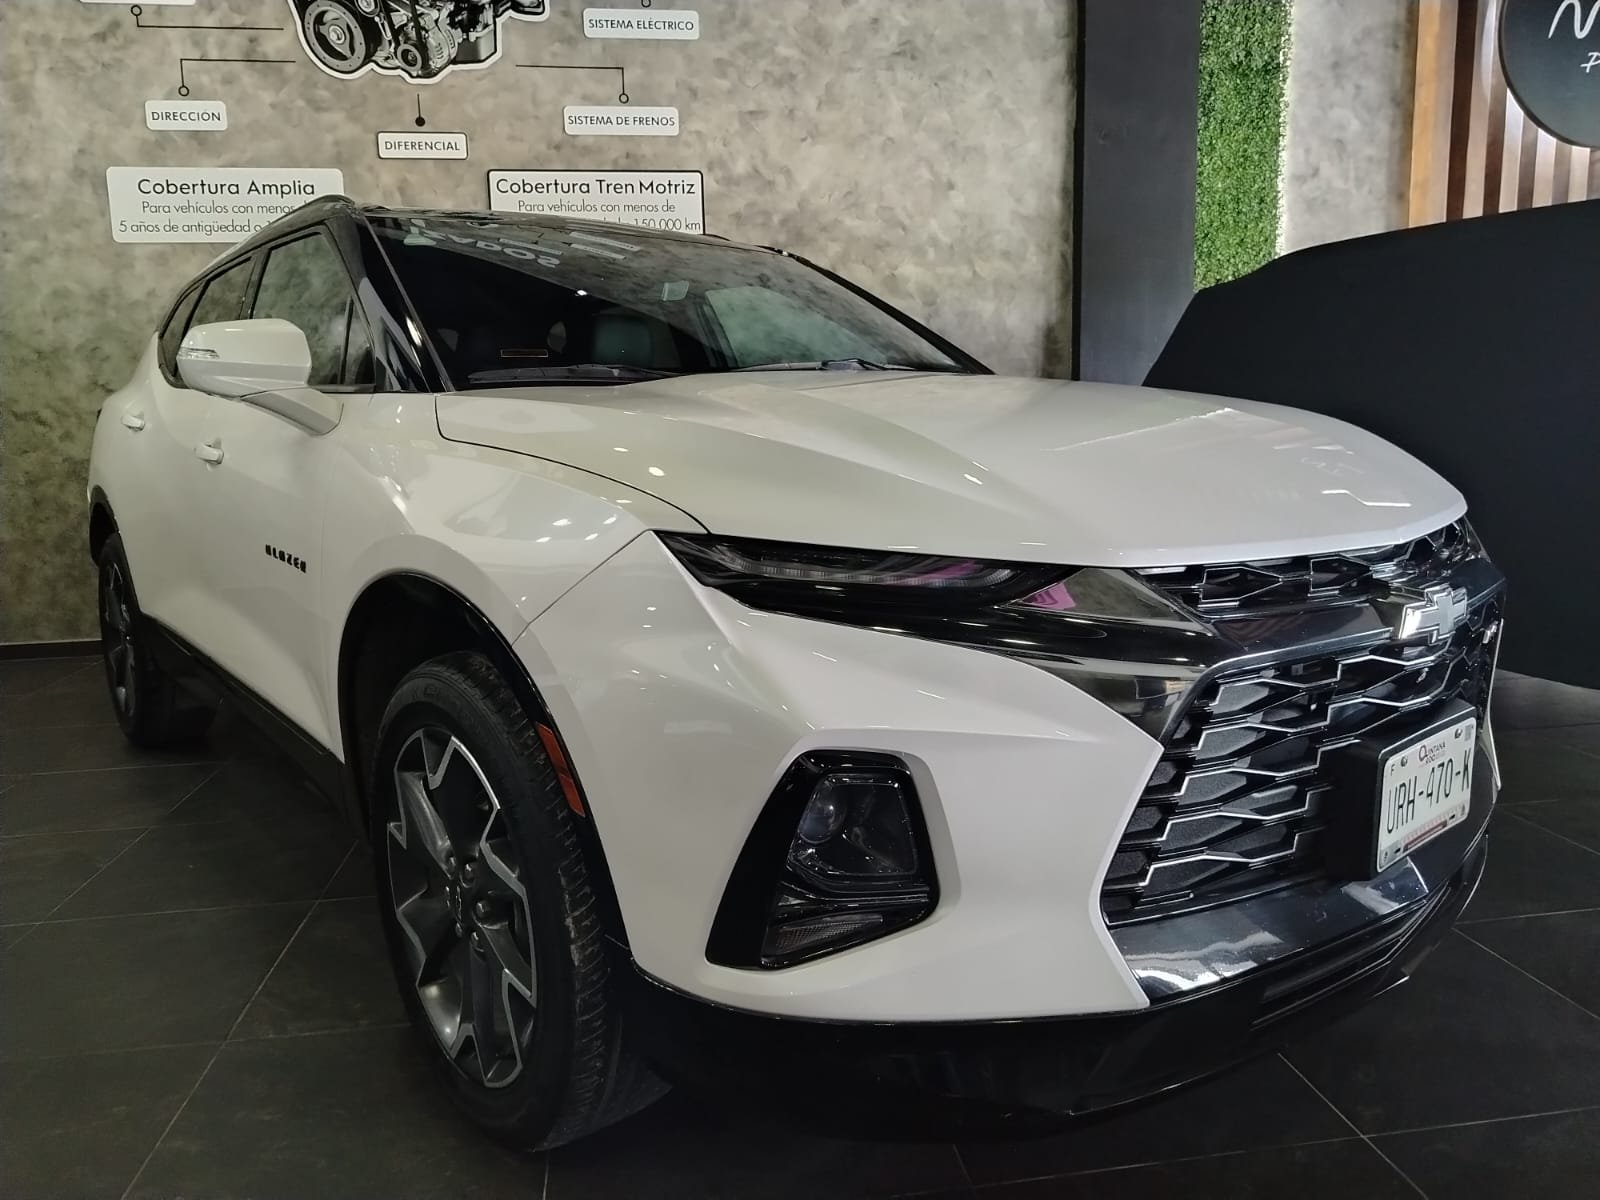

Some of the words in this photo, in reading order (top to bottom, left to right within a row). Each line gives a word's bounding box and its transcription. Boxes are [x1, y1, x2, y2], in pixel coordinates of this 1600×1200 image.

[588, 18, 634, 30] SISTEMA
[636, 17, 694, 31] ELÉCTRICO
[151, 108, 221, 121] DIRECCIÓN
[567, 115, 613, 126] SISTEMA
[615, 116, 630, 126] DE
[633, 116, 675, 127] FRENOS
[384, 140, 460, 151] DIFERENCIAL
[137, 179, 240, 195] Cobertura
[246, 179, 315, 199] Amplia
[496, 179, 590, 194] Cobertura
[595, 179, 635, 194] Tren
[639, 180, 696, 195] Motriz
[142, 202, 171, 214] Para
[174, 201, 229, 214] vehículos
[231, 205, 253, 214] con
[518, 200, 545, 212] Para
[547, 199, 598, 212] vehículos
[600, 203, 621, 212] con
[623, 203, 659, 213] menos
[661, 200, 676, 213] de
[119, 221, 128, 232] 5
[130, 221, 160, 232] años
[163, 220, 179, 232] de
[182, 219, 251, 236] antigüedad
[685, 217, 701, 231] km
[265, 544, 307, 574] BLAZER
[1387, 747, 1472, 834] URH-470-K
